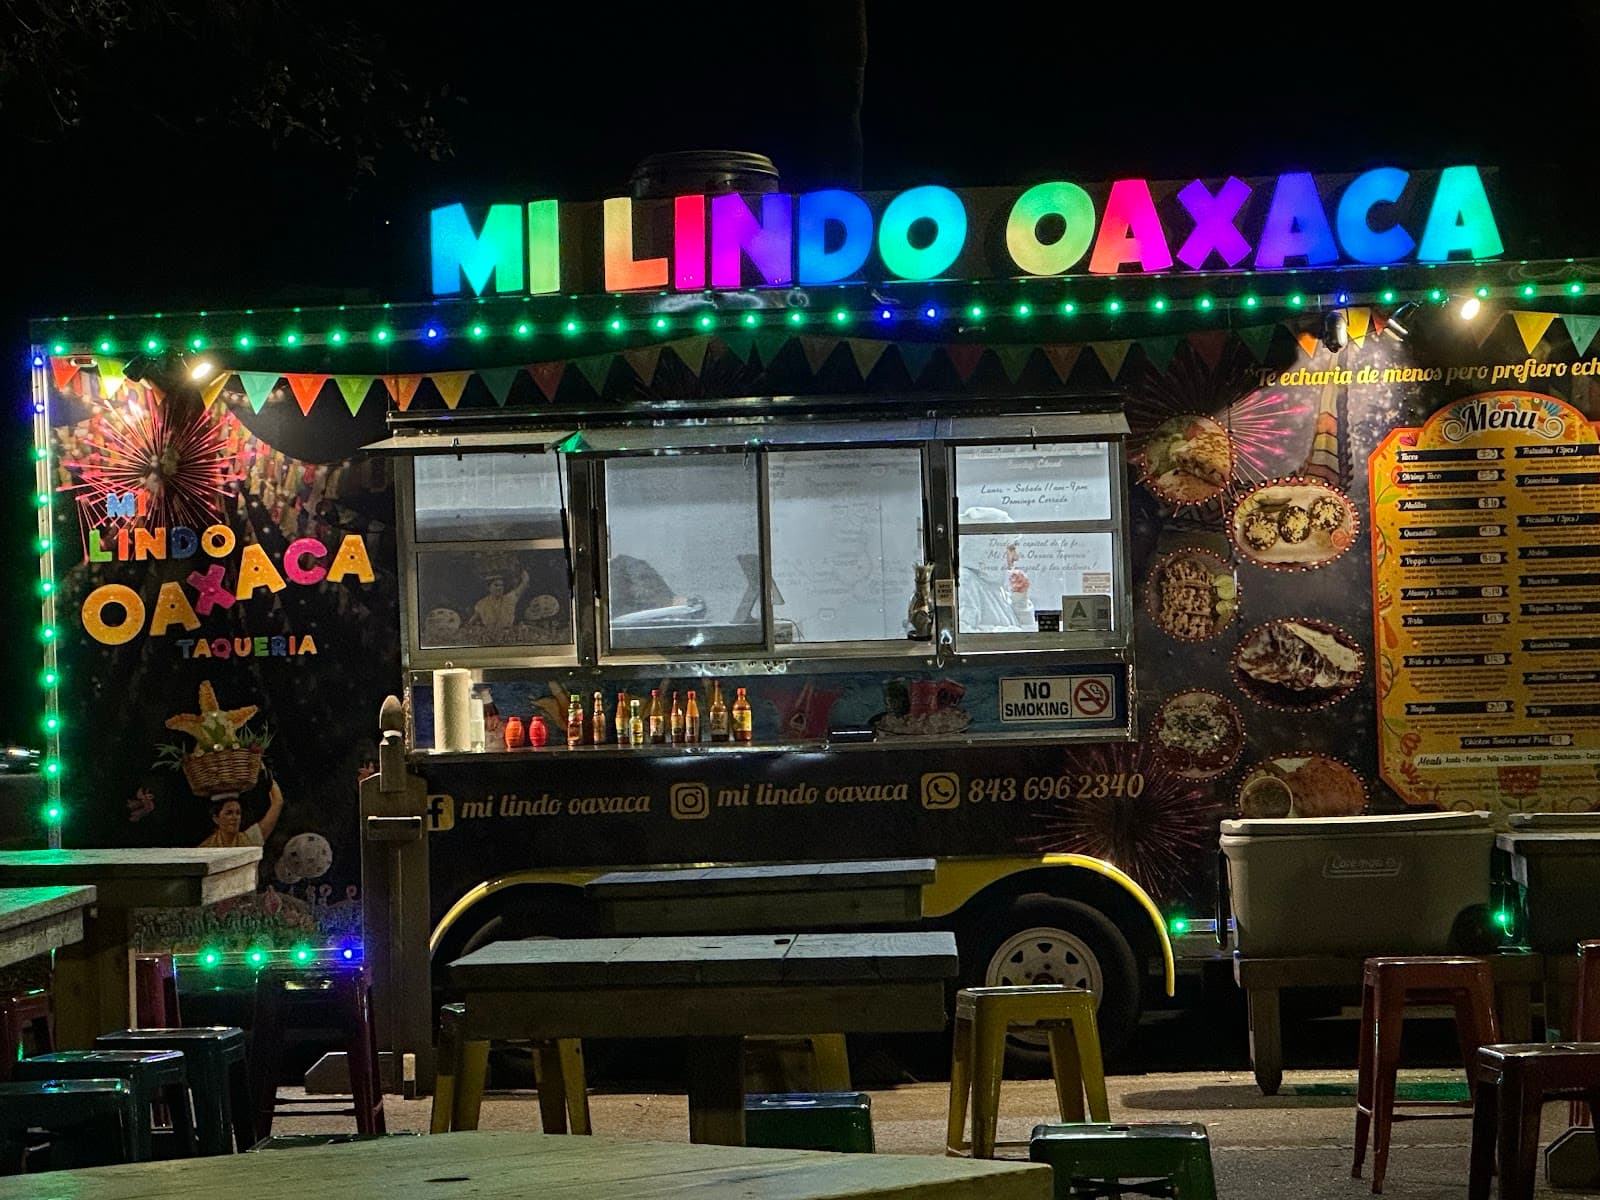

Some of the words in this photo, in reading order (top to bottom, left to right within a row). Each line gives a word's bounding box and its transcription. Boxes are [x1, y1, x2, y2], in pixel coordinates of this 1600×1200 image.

[430, 198, 560, 296] MI
[603, 185, 967, 293] LINDO
[1006, 165, 1505, 276] OAXACA
[1279, 365, 1353, 386] echaria
[1356, 365, 1380, 384] de
[1382, 367, 1443, 384] menos
[1445, 366, 1488, 386] pero
[1491, 361, 1567, 384] prefiero
[1460, 400, 1538, 432] Menu
[1427, 472, 1442, 480] Taco
[106, 488, 147, 518] MI
[88, 524, 236, 562] LINDO
[81, 534, 375, 645] OAXACA
[1071, 600, 1087, 618] A
[176, 634, 317, 660] TAQUERIA
[1023, 681, 1051, 700] NO
[1004, 701, 1069, 719] SMOKING
[717, 784, 750, 807] mi
[756, 782, 818, 806] lindo
[825, 782, 908, 803] oaxaca
[968, 777, 1016, 803] 843
[1023, 776, 1070, 801] 696
[1076, 773, 1145, 800] 2340
[461, 795, 492, 818] mi
[499, 794, 562, 817] lindo
[568, 794, 651, 815] oaxaca
